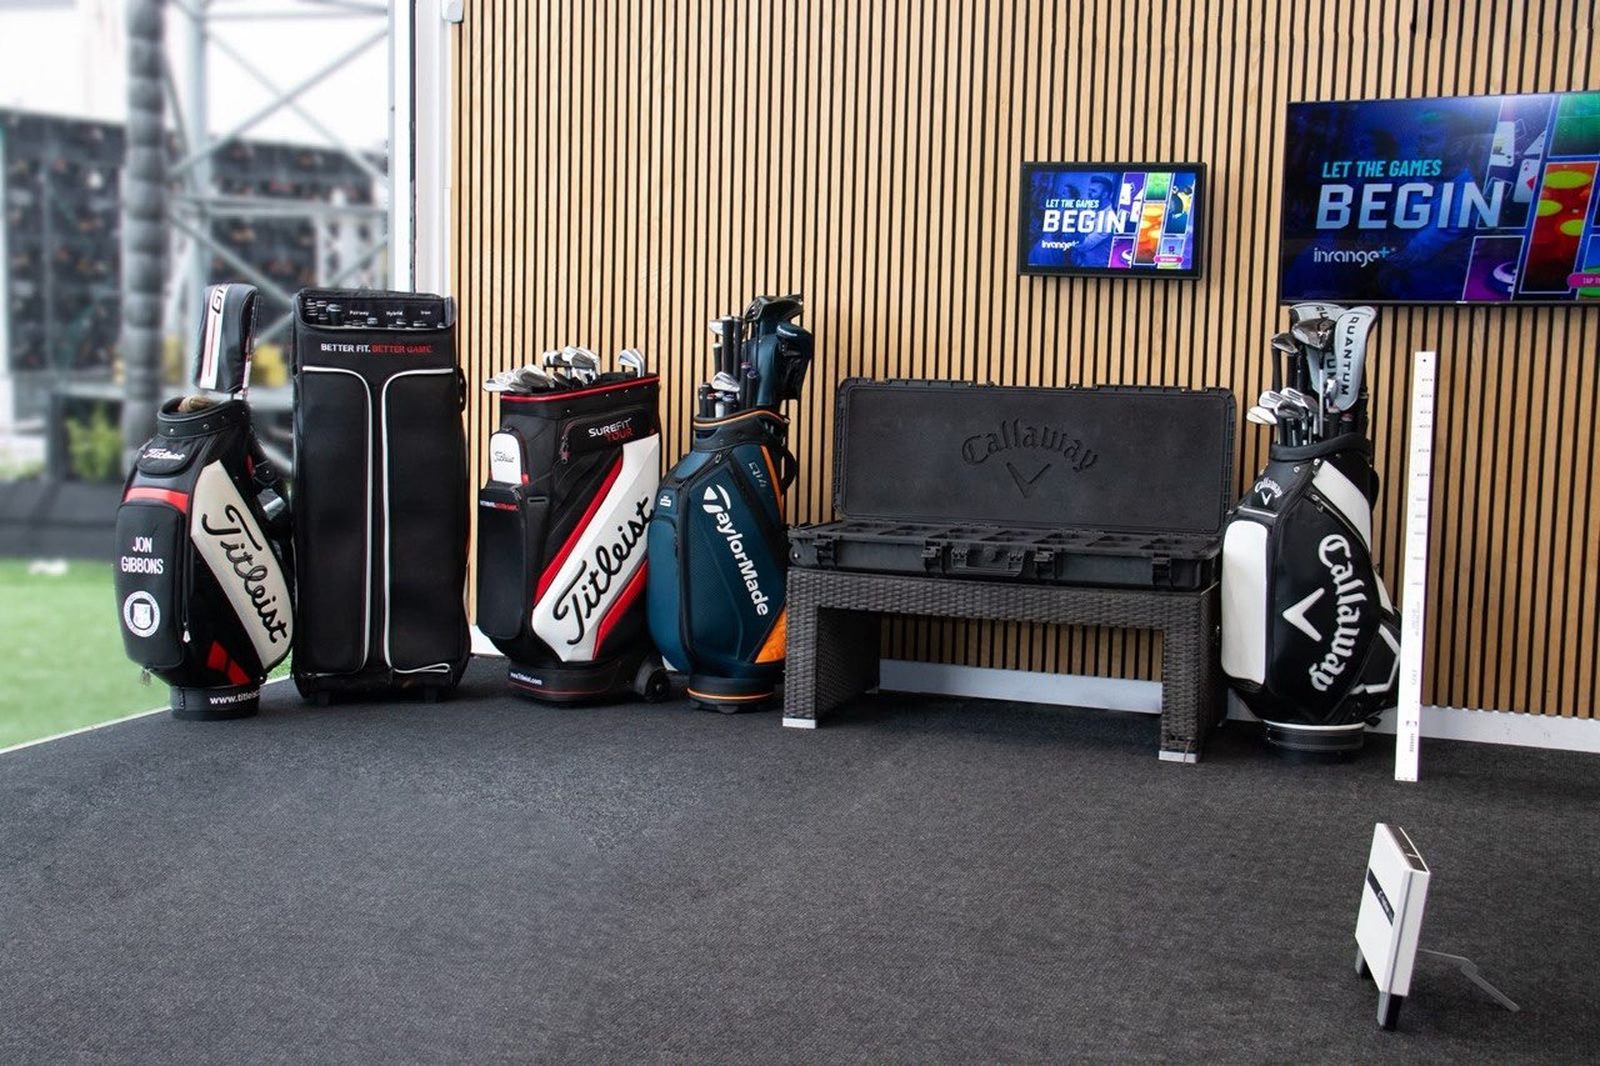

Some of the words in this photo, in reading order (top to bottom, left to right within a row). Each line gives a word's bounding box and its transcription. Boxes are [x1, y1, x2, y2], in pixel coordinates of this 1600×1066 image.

[1322, 161, 1352, 179] LET
[1356, 160, 1386, 178] THE
[1389, 159, 1443, 178] GAME
[1045, 199, 1060, 209] LET
[1061, 199, 1075, 209] THE
[1075, 199, 1100, 209] GAME
[1315, 181, 1505, 230] BEGIN
[1042, 209, 1128, 234] BEGIN
[321, 343, 354, 353] BETTER
[355, 344, 371, 353] FIT.
[372, 344, 405, 354] BETTER
[1341, 316, 1360, 396] QUANTUM
[588, 417, 632, 438] SUREFIT
[605, 428, 634, 441] TOUR
[961, 418, 1099, 473] Callaway
[132, 537, 153, 553] JON
[702, 484, 769, 616] TaylorMade
[120, 558, 164, 574] GIBBONS
[201, 504, 287, 644] Titleist
[553, 496, 655, 645] Titleist
[1308, 534, 1368, 692] Callaway
